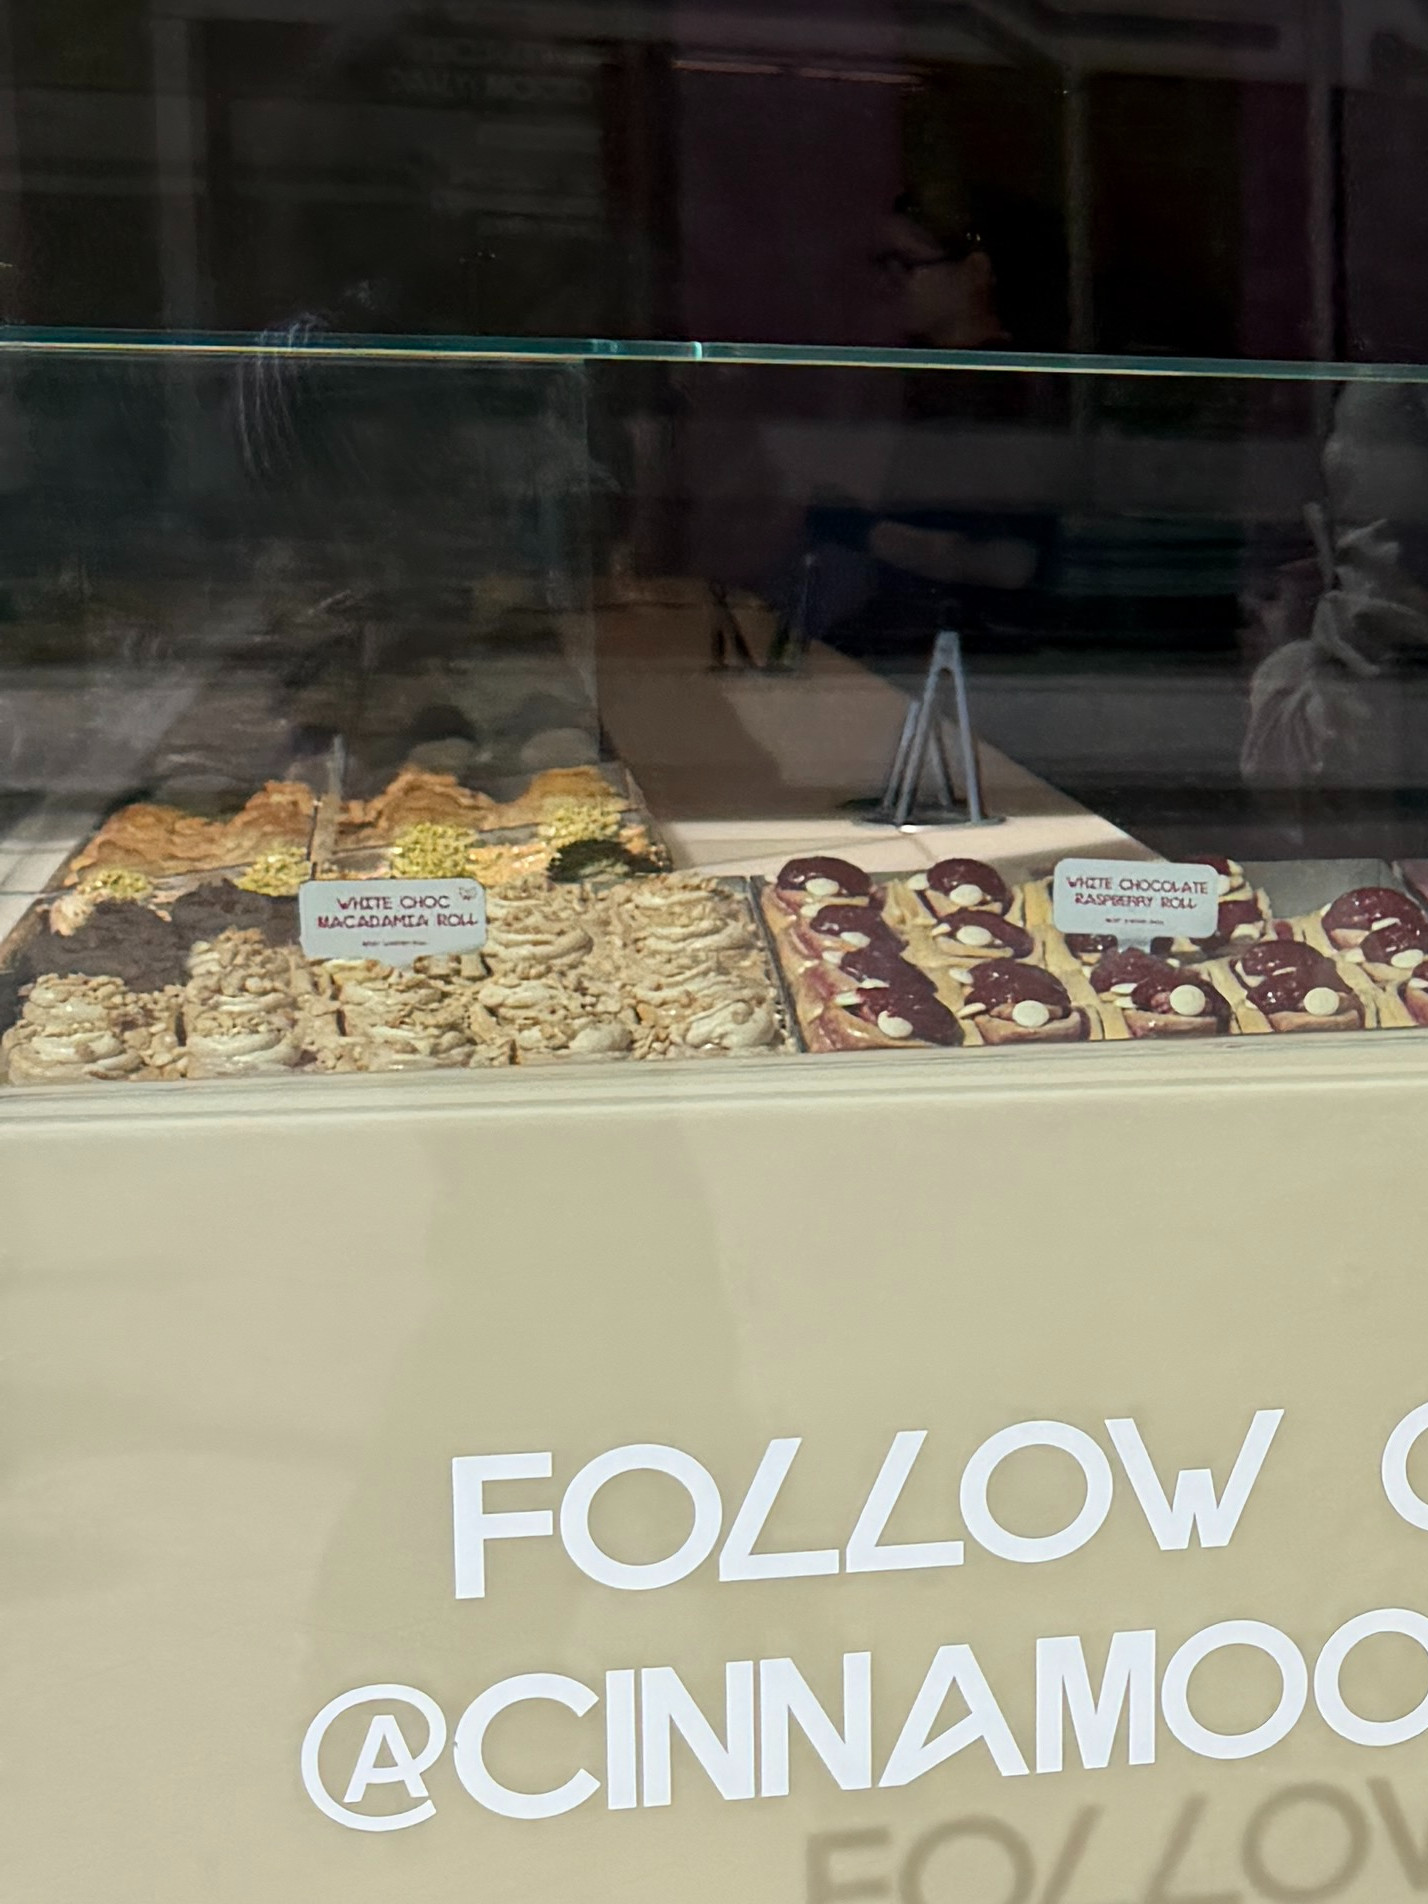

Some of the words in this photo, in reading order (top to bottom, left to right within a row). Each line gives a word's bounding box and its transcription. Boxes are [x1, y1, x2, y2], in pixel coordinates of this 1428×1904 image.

[1066, 876, 1113, 890] WHITE
[1119, 877, 1209, 895] CHOCOLATE
[337, 895, 393, 910] WHITE
[400, 895, 451, 910] CHOC
[1074, 892, 1154, 909] RASPBERRY
[1161, 896, 1197, 910] ROLL
[316, 913, 429, 929] MACADAMIA
[436, 912, 479, 928] ROLL
[451, 1408, 1285, 1600] FOLLOW
